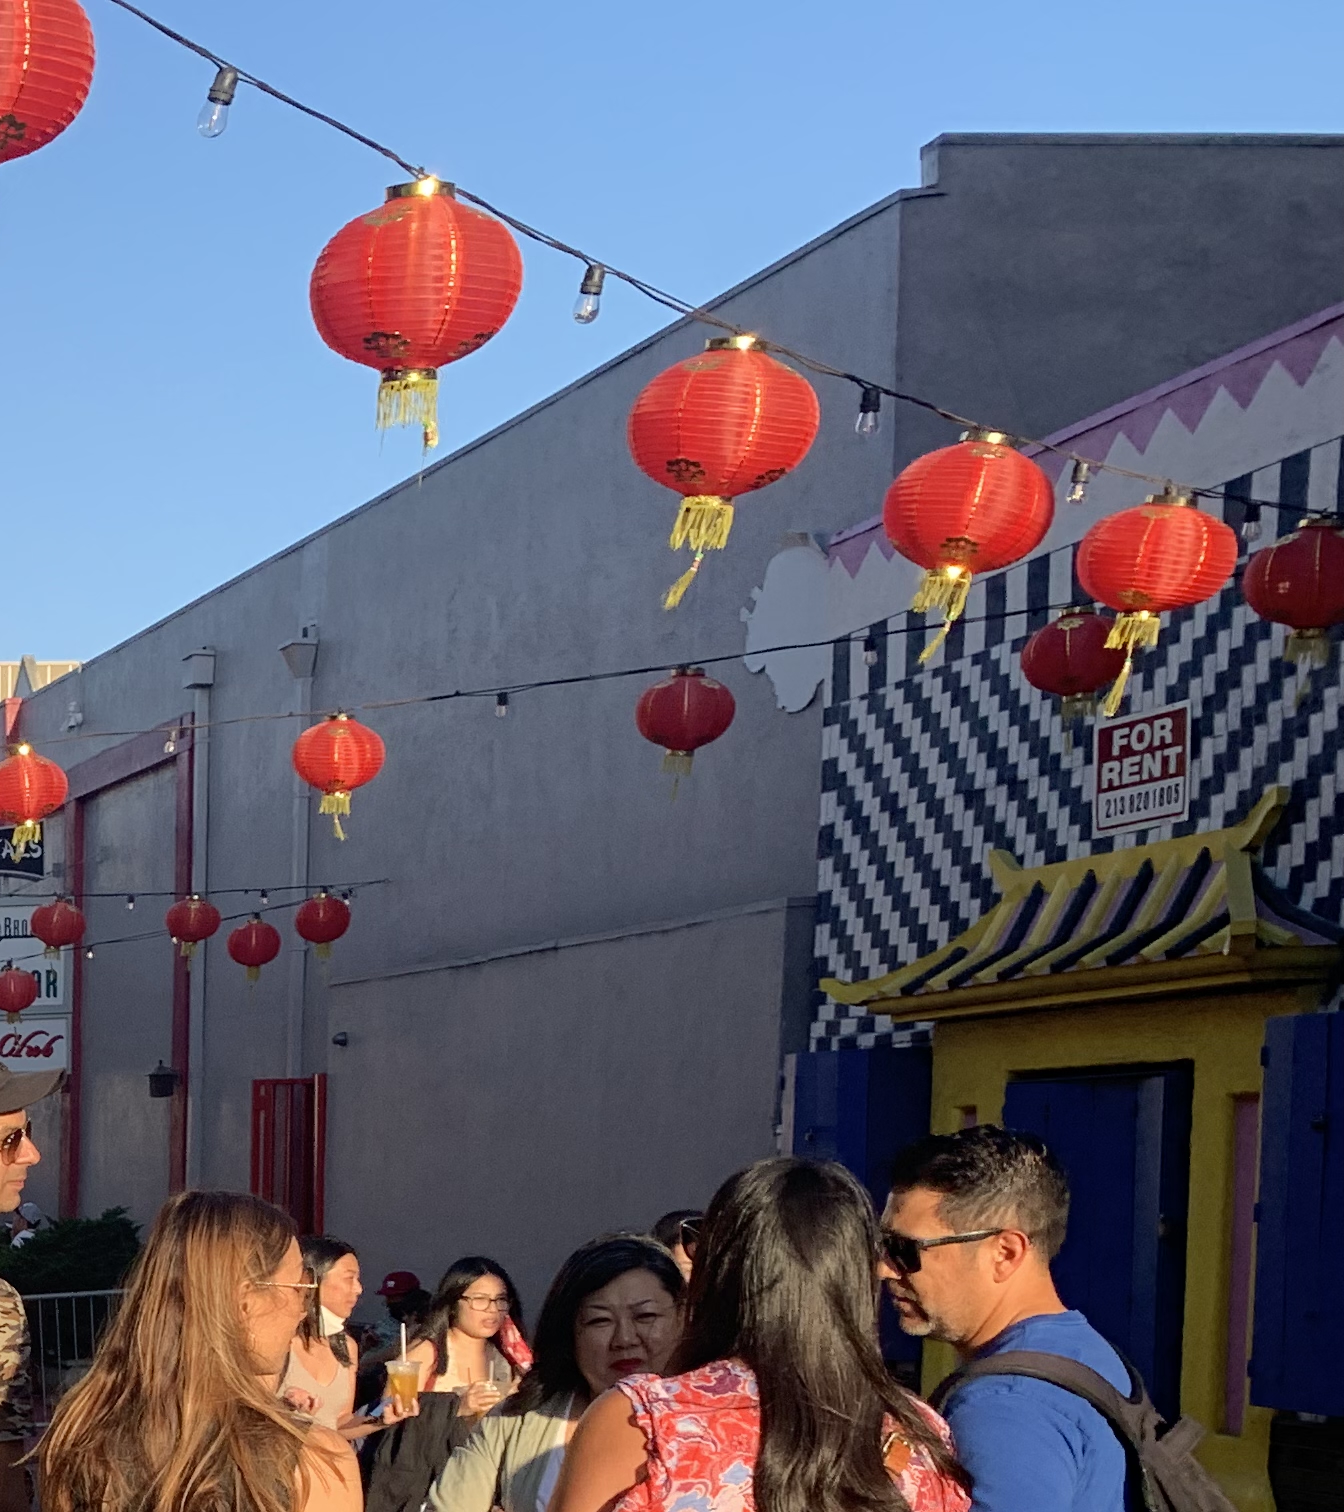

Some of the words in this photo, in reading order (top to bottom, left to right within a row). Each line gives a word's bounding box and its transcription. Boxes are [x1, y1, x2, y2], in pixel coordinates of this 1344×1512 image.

[1112, 717, 1173, 756] FOR
[1101, 745, 1183, 789] RENT
[1105, 796, 1125, 818] 213
[1153, 783, 1180, 808] 1805
